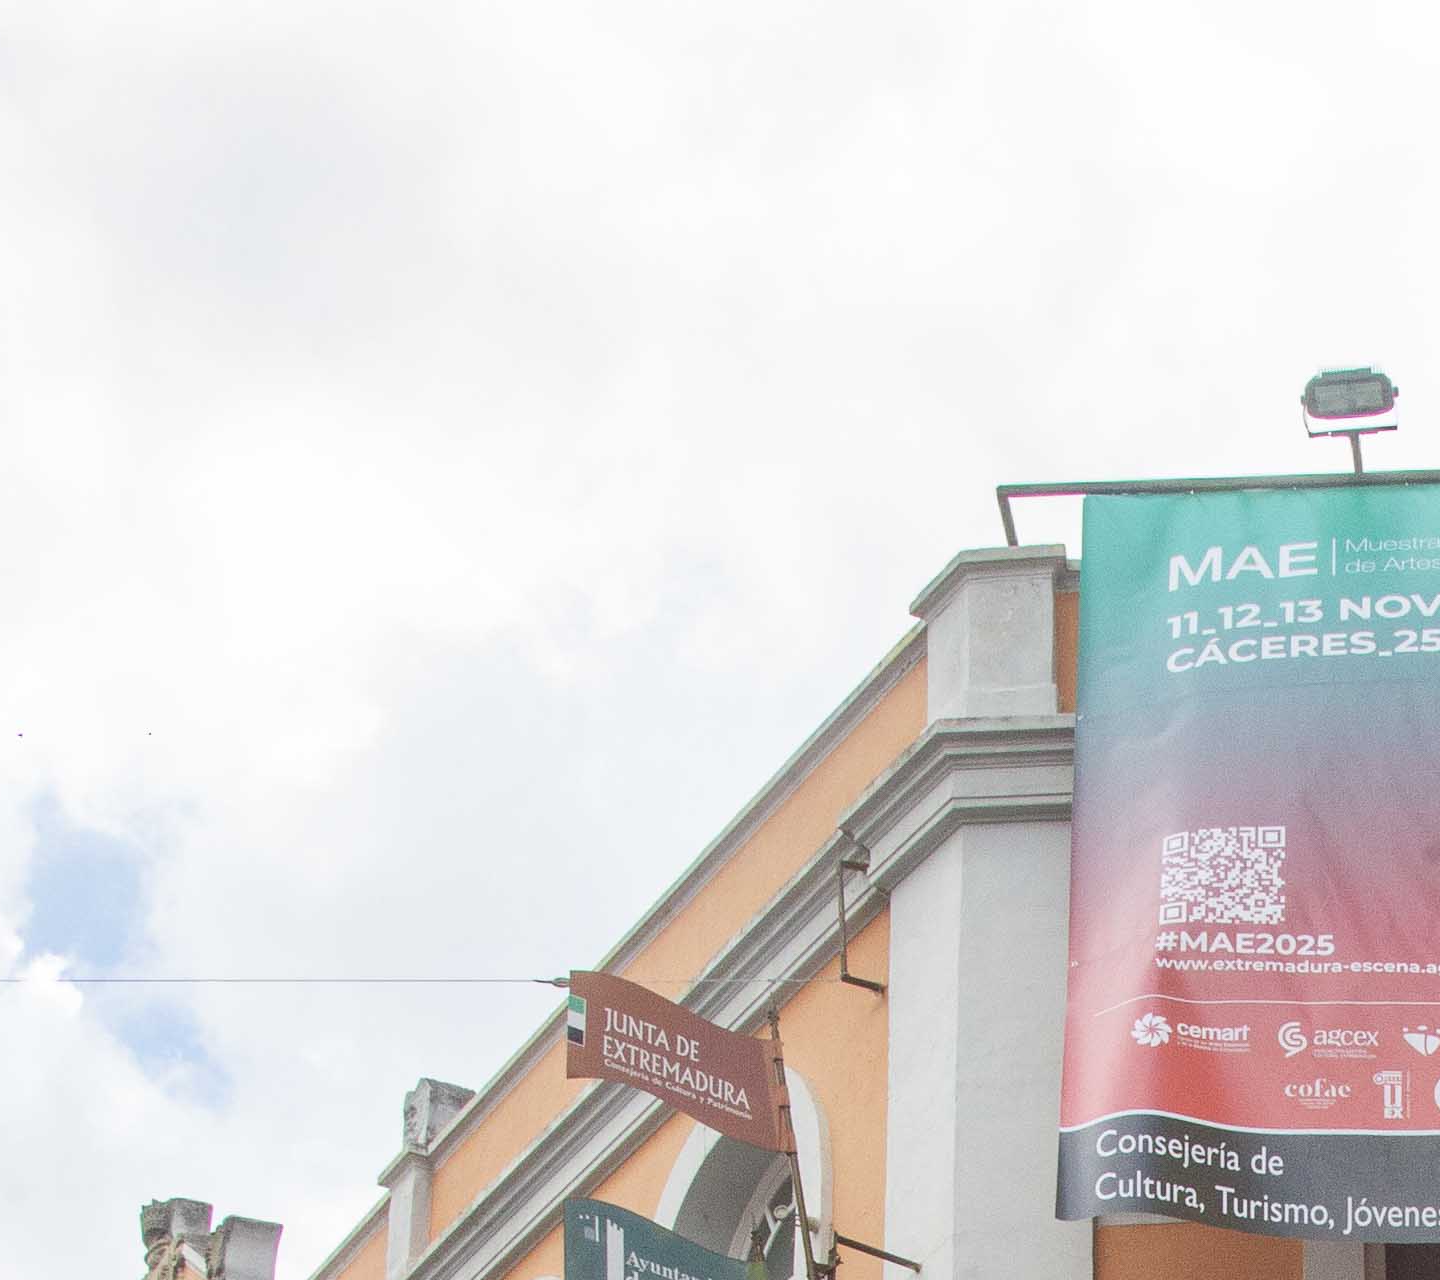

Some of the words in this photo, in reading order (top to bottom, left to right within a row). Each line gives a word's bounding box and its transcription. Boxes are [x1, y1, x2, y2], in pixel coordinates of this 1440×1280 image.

[1344, 535, 1440, 554] Muestra
[1168, 541, 1319, 593] MAE
[1344, 558, 1376, 574] de
[1167, 600, 1324, 640] 11_12_13
[1155, 931, 1335, 957] #MAE2025
[604, 1007, 670, 1051] JUNTA
[676, 1034, 700, 1062] DE
[1177, 1022, 1250, 1041] cemart
[1313, 1028, 1379, 1047] agcex
[603, 1034, 752, 1111] EXTREMADURA
[665, 1081, 696, 1099] Cultura
[1284, 1078, 1352, 1098] cofae
[1095, 1128, 1241, 1172] Consejería
[1250, 1146, 1285, 1176] de
[1094, 1171, 1207, 1214] Cultura,
[1215, 1184, 1335, 1230] Turismo,
